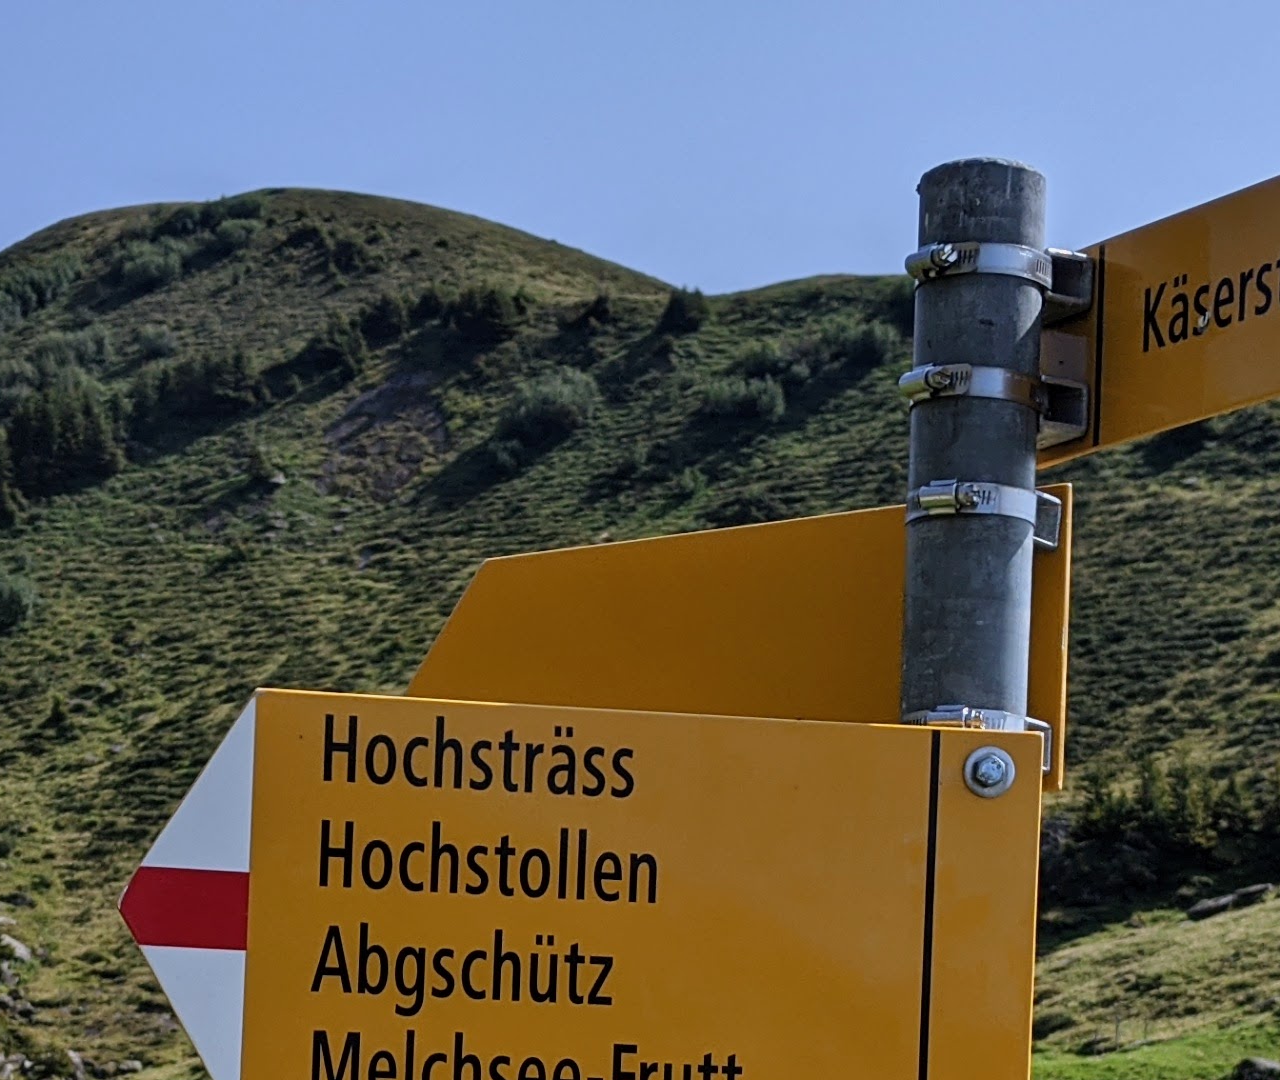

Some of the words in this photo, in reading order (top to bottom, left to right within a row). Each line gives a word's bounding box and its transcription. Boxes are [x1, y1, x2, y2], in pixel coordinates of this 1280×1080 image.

[322, 713, 635, 799] Hochsträss
[318, 818, 658, 904] Hochstollen
[310, 921, 614, 1018] Abgschütz
